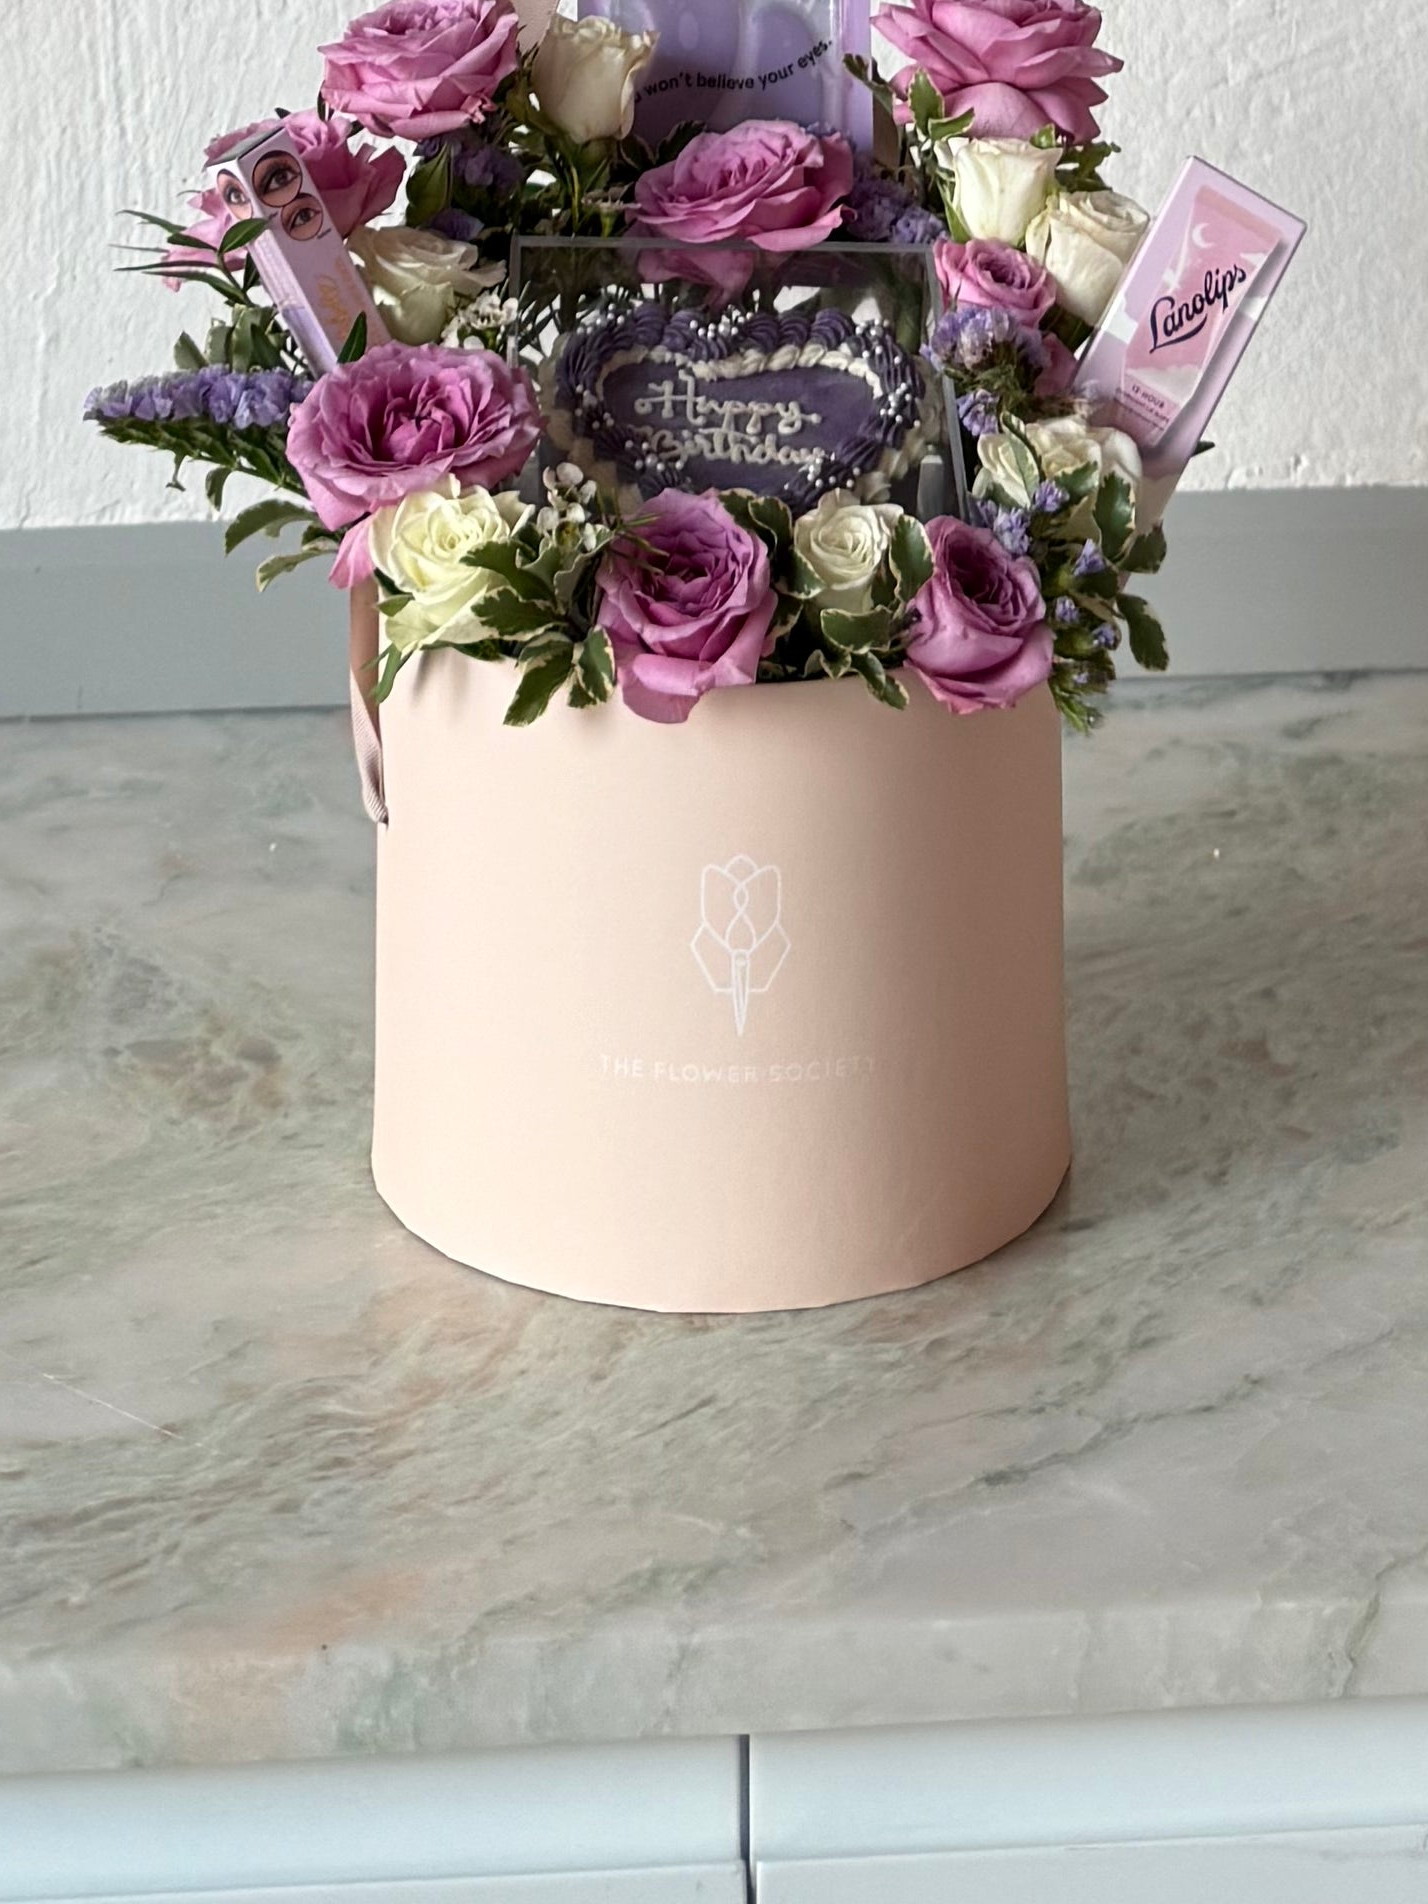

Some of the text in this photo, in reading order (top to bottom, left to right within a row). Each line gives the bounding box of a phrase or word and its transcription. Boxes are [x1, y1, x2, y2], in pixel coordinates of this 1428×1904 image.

[644, 40, 832, 96] won't believe your eyes.
[1149, 264, 1247, 355] Lanolips
[634, 369, 822, 435] Happy
[600, 1055, 644, 1080] THE
[654, 1060, 758, 1083] FLOWER
